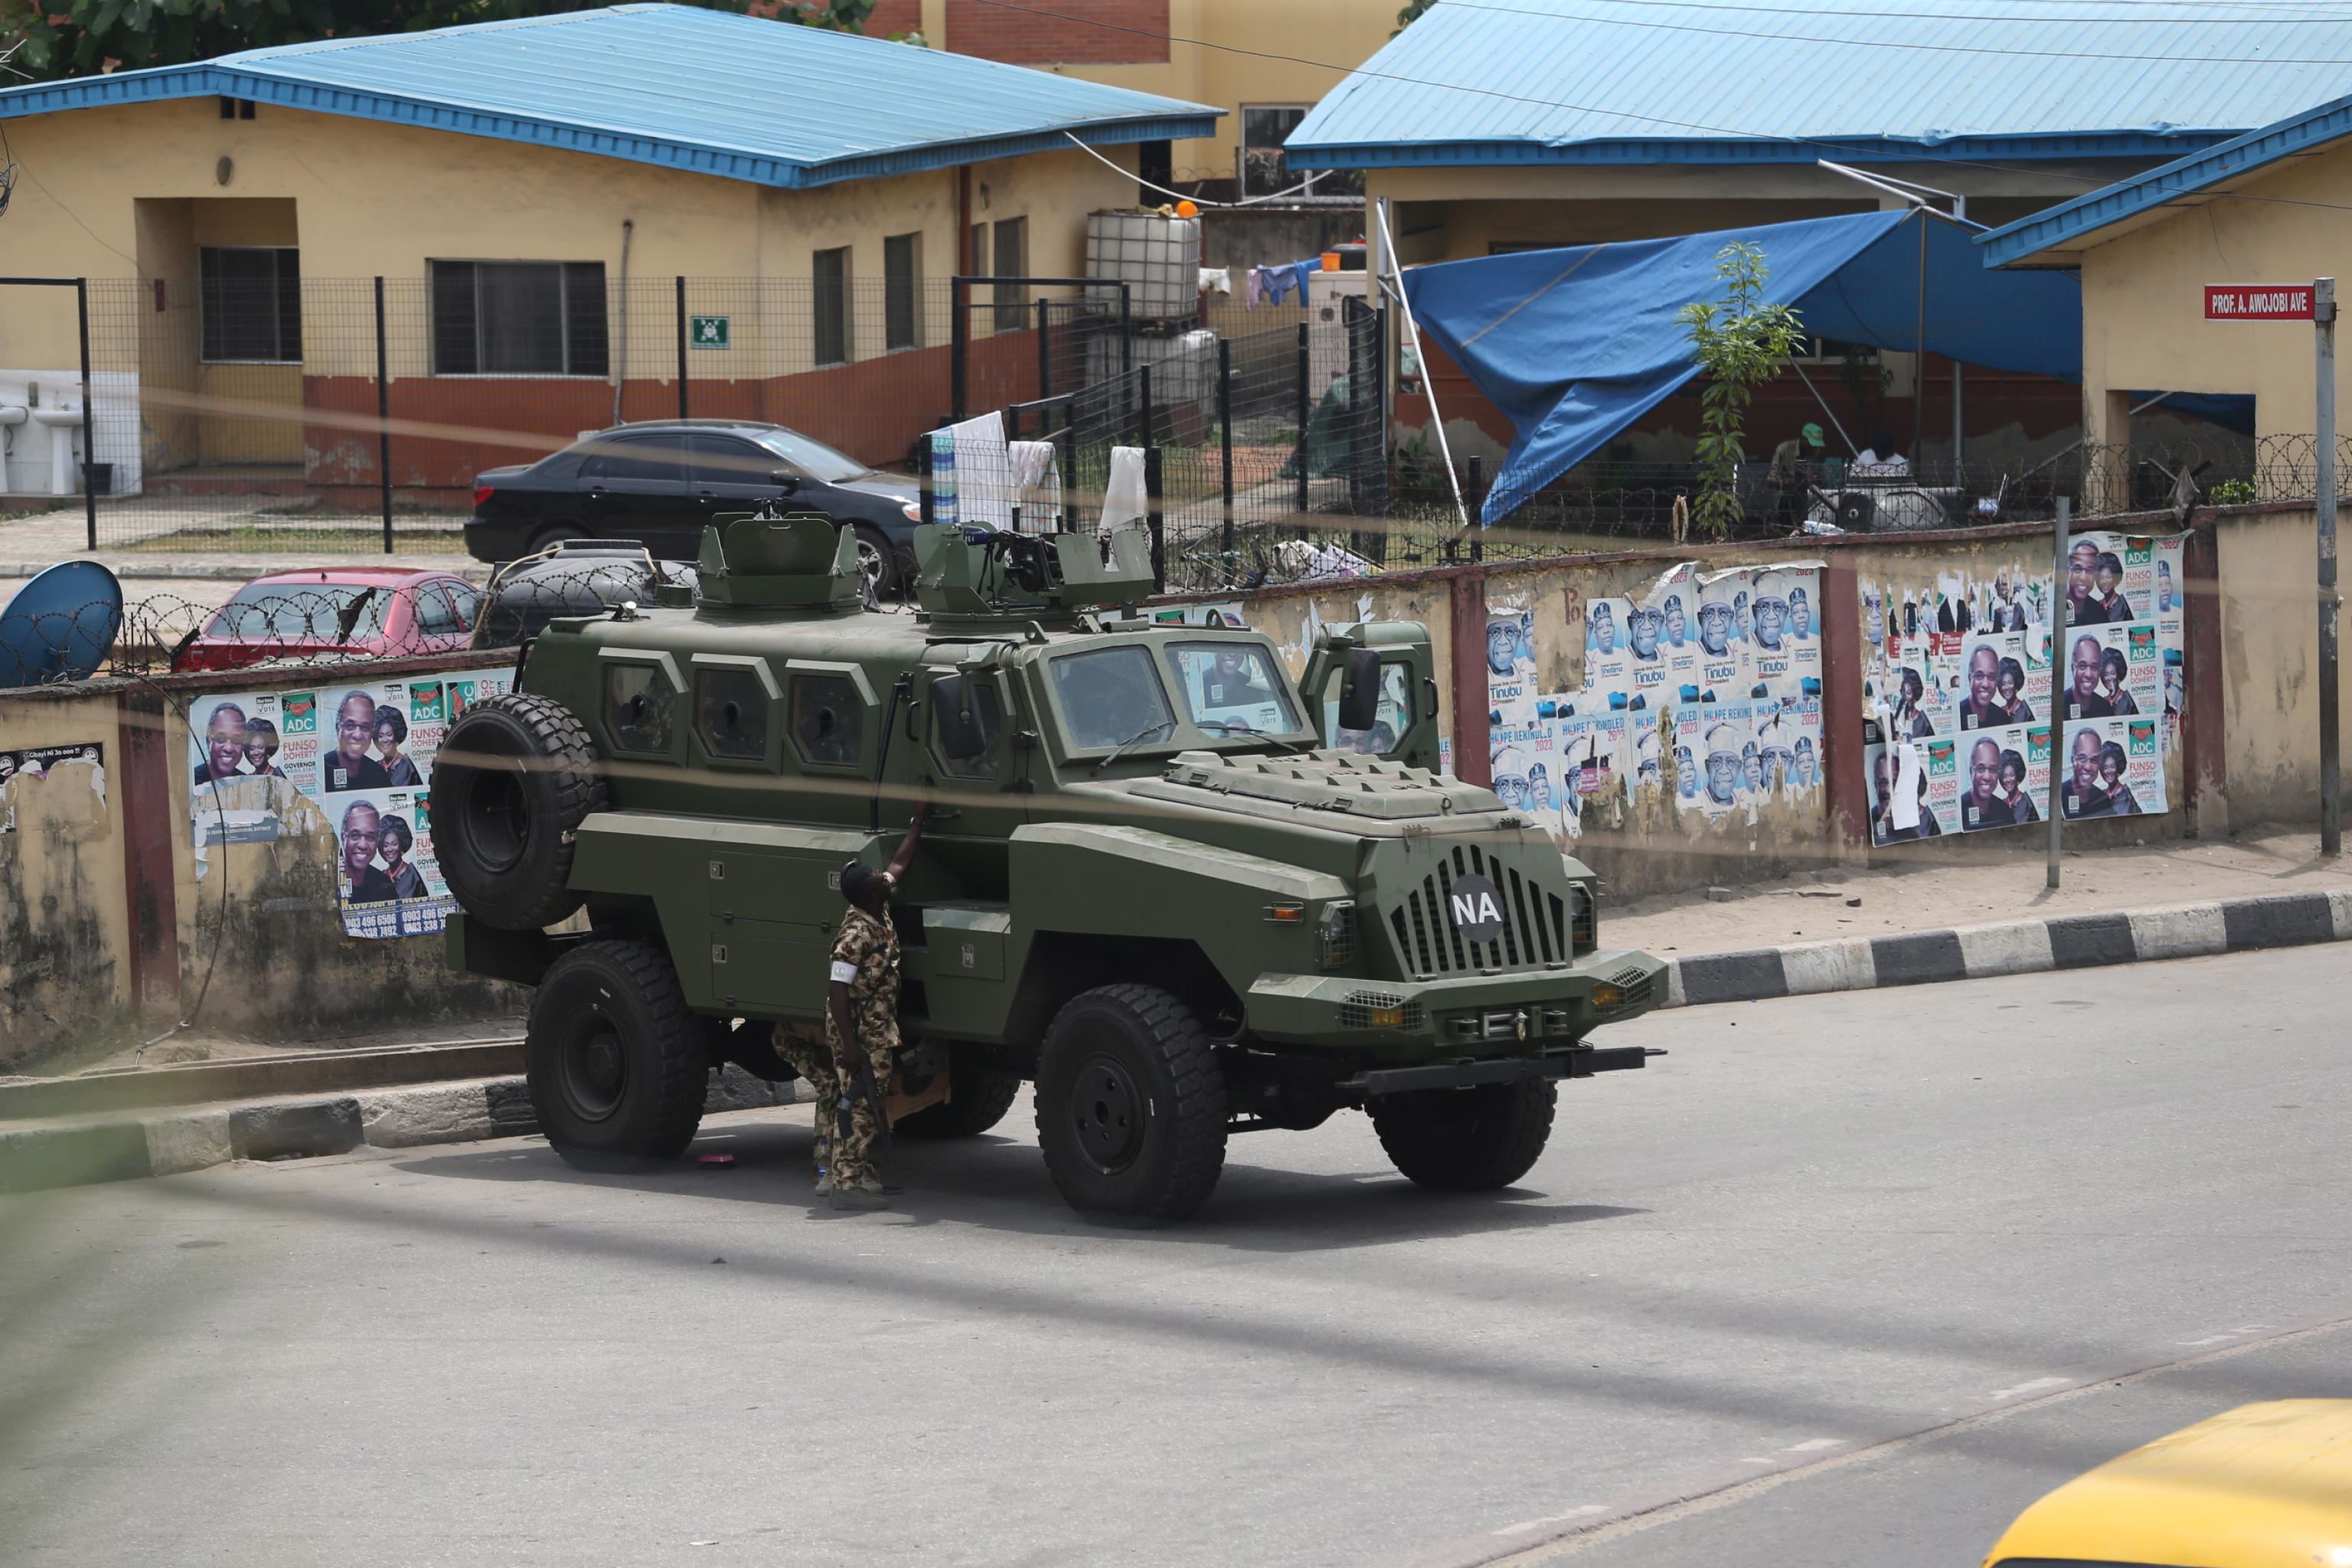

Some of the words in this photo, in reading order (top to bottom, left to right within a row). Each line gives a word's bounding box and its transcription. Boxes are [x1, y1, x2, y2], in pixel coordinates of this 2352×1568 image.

[2212, 294, 2236, 314] PROF.
[2238, 293, 2247, 313] A.
[2249, 292, 2288, 313] AWOJOBI
[2290, 292, 2308, 312] AVE
[2127, 551, 2148, 564] ADC
[2125, 570, 2151, 582] FUNSO
[2132, 647, 2153, 659] ADC
[1756, 659, 1788, 672] Tinubu
[2130, 665, 2157, 677] FUNSO
[1633, 670, 1665, 684] Tinubu
[1704, 666, 1736, 680] Tinubu
[2131, 675, 2157, 684] DOHERTY
[1490, 686, 1522, 699] Tinubu
[414, 706, 441, 720] ADC
[1801, 714, 1819, 725] 2023
[286, 718, 313, 733] ADC
[1680, 721, 1697, 735] 2023
[411, 727, 444, 740] FUNSO
[283, 740, 318, 753] FUNSO
[1534, 739, 1553, 752] 2023
[2132, 742, 2153, 754] ADC
[283, 750, 318, 761] DOHERTY
[2030, 748, 2051, 761] ADC
[284, 761, 316, 769] GOVERNOR
[1932, 761, 1954, 775] ADC
[2130, 761, 2157, 771] FUNSO
[2029, 768, 2050, 779] FUNS
[1930, 780, 1957, 792] FUNSO
[1931, 789, 1957, 799] DOHERTY
[422, 908, 436, 920] 496
[1452, 892, 1502, 926] NA
[362, 915, 376, 926] 496
[377, 913, 397, 926] 6506
